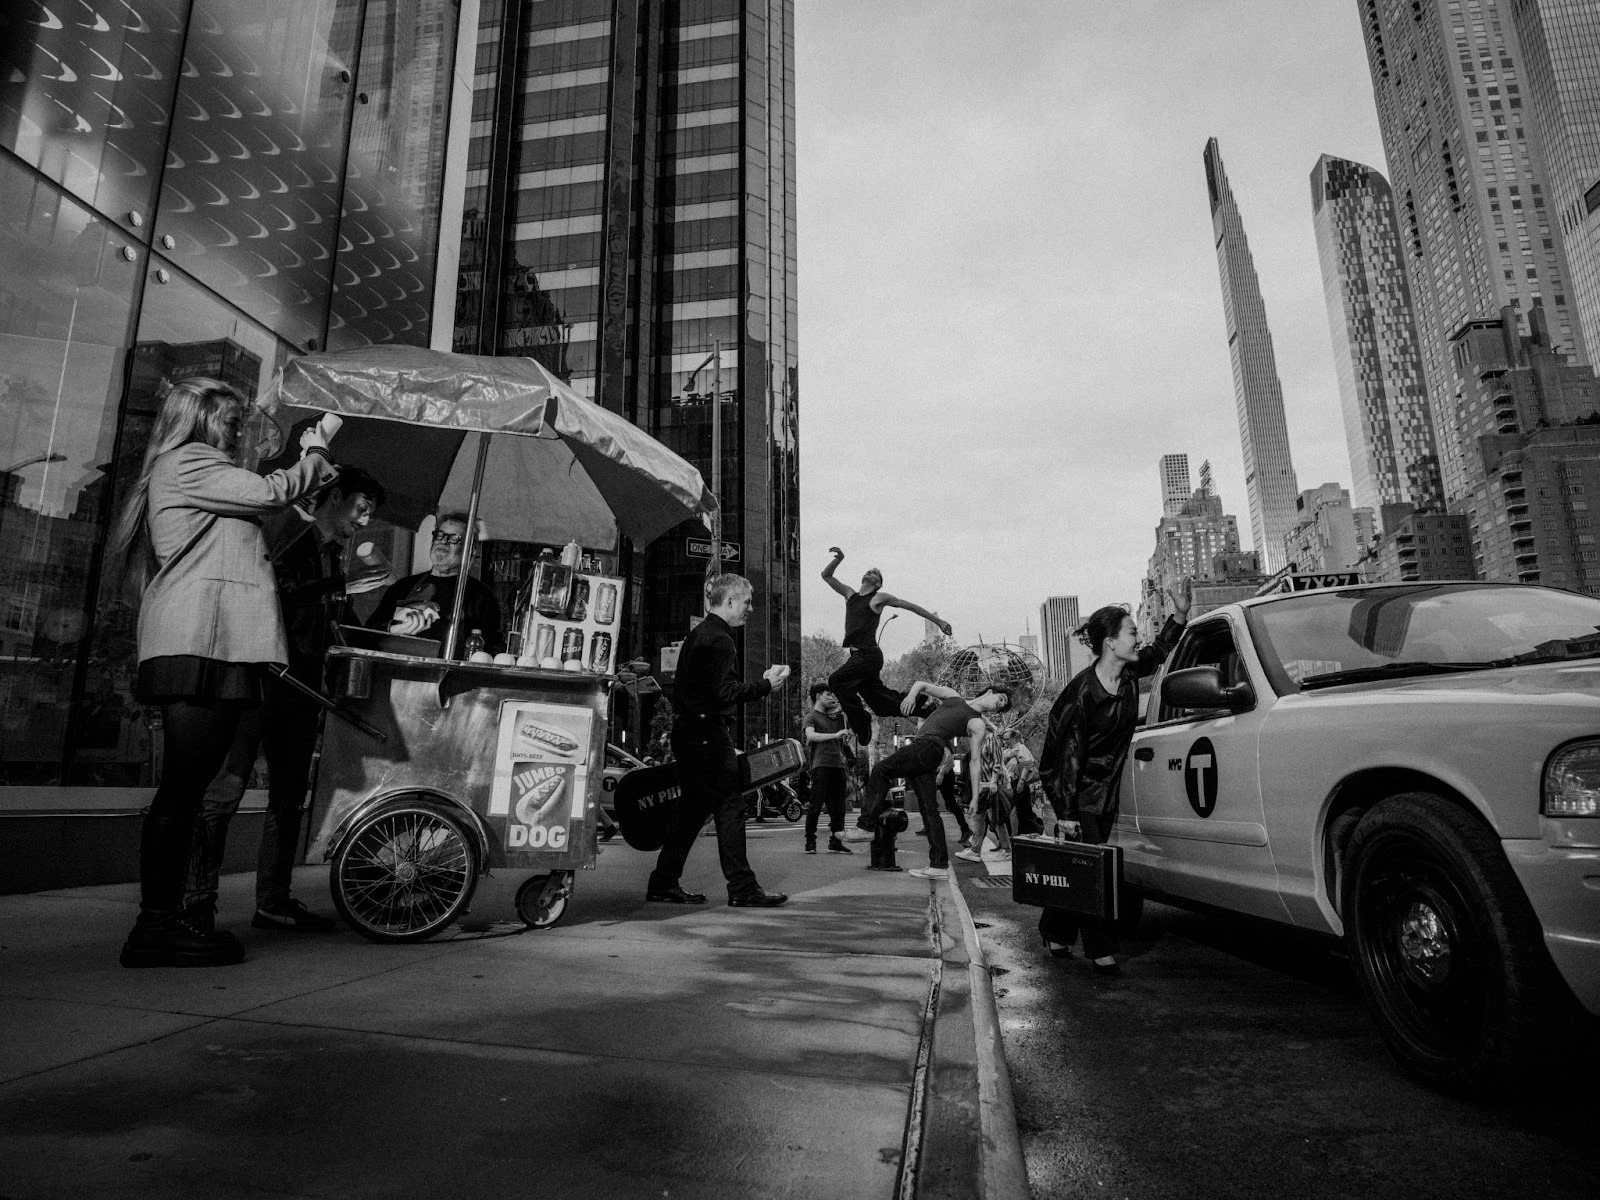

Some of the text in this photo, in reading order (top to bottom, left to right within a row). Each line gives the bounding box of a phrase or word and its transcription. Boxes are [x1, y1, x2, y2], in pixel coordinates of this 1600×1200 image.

[692, 544, 708, 552] ONE
[1300, 575, 1351, 590] 7X27
[562, 645, 582, 654] SODA
[513, 767, 566, 795] JUMBO
[605, 779, 615, 790] T
[1168, 753, 1212, 808] NYC T
[637, 785, 682, 811] NY PHI
[509, 825, 567, 848] DOG
[1025, 872, 1069, 888] NY PHIL
